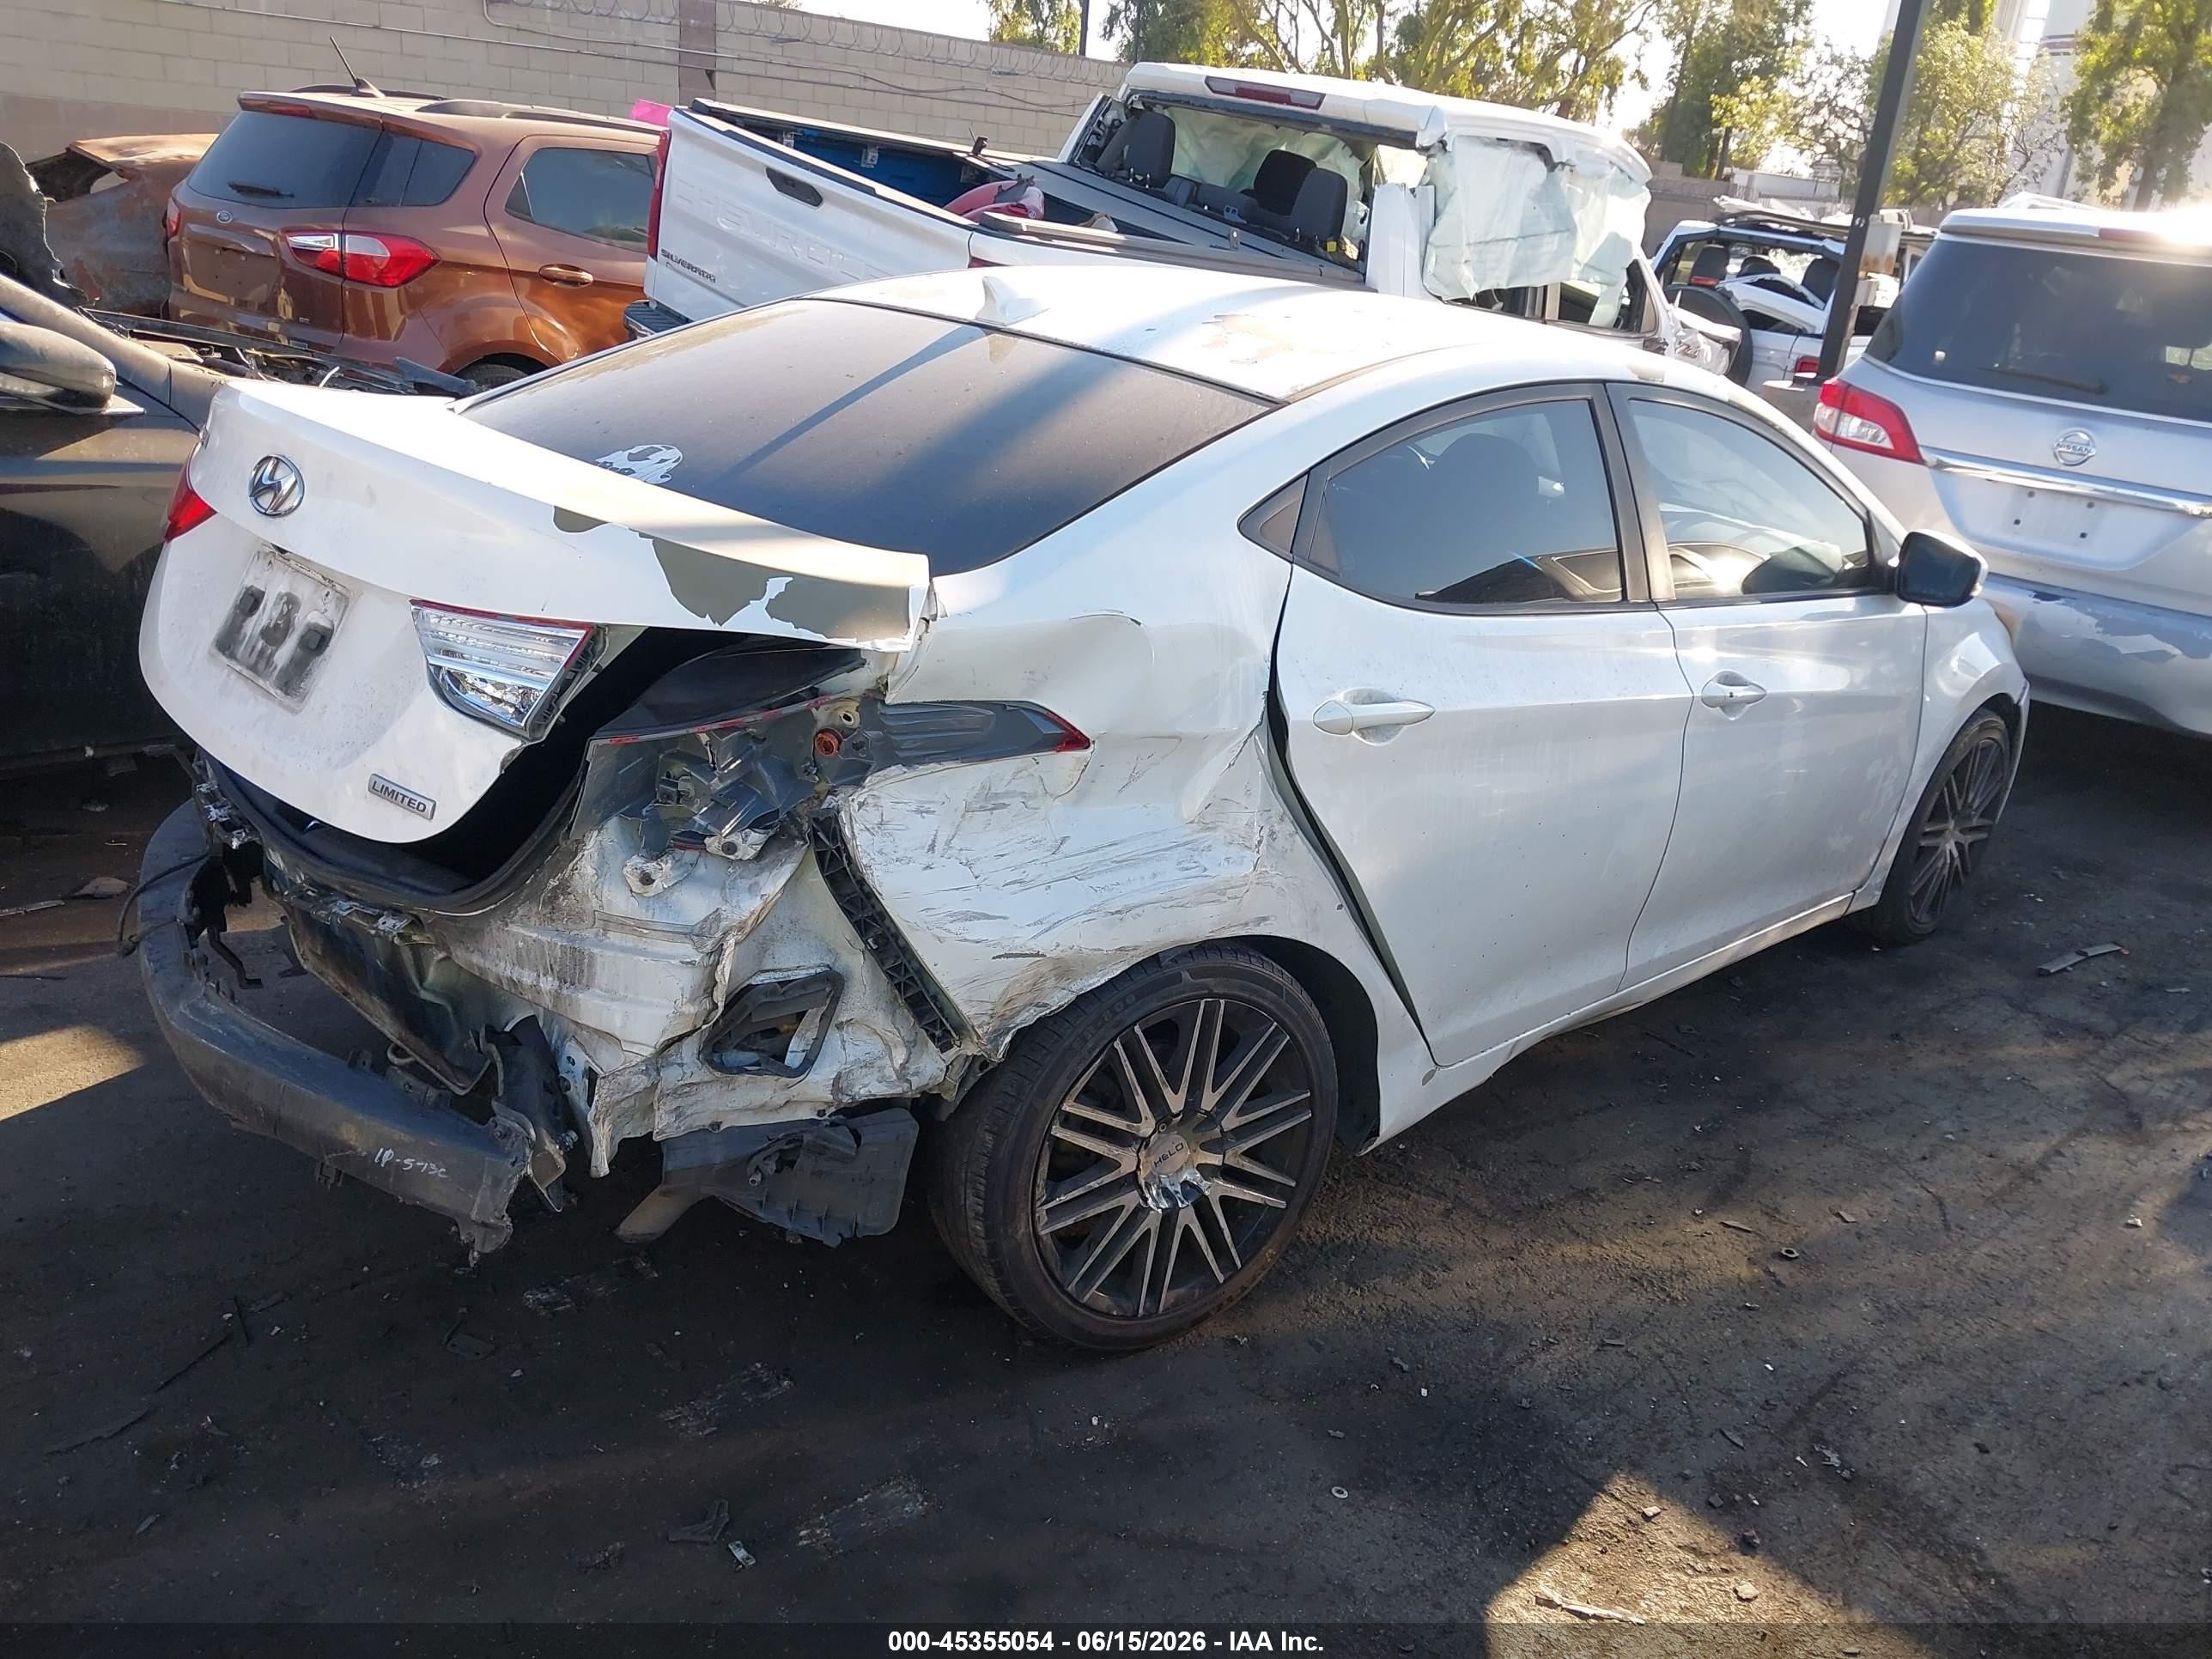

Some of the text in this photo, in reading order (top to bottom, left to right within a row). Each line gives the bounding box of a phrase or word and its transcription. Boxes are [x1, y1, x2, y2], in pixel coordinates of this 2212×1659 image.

[673, 177, 895, 282] CHEVROLE
[660, 247, 716, 284] SILVERADO
[2055, 441, 2094, 455] NISSAN
[371, 780, 427, 813] LIMITED
[1153, 1142, 1184, 1168] HELO
